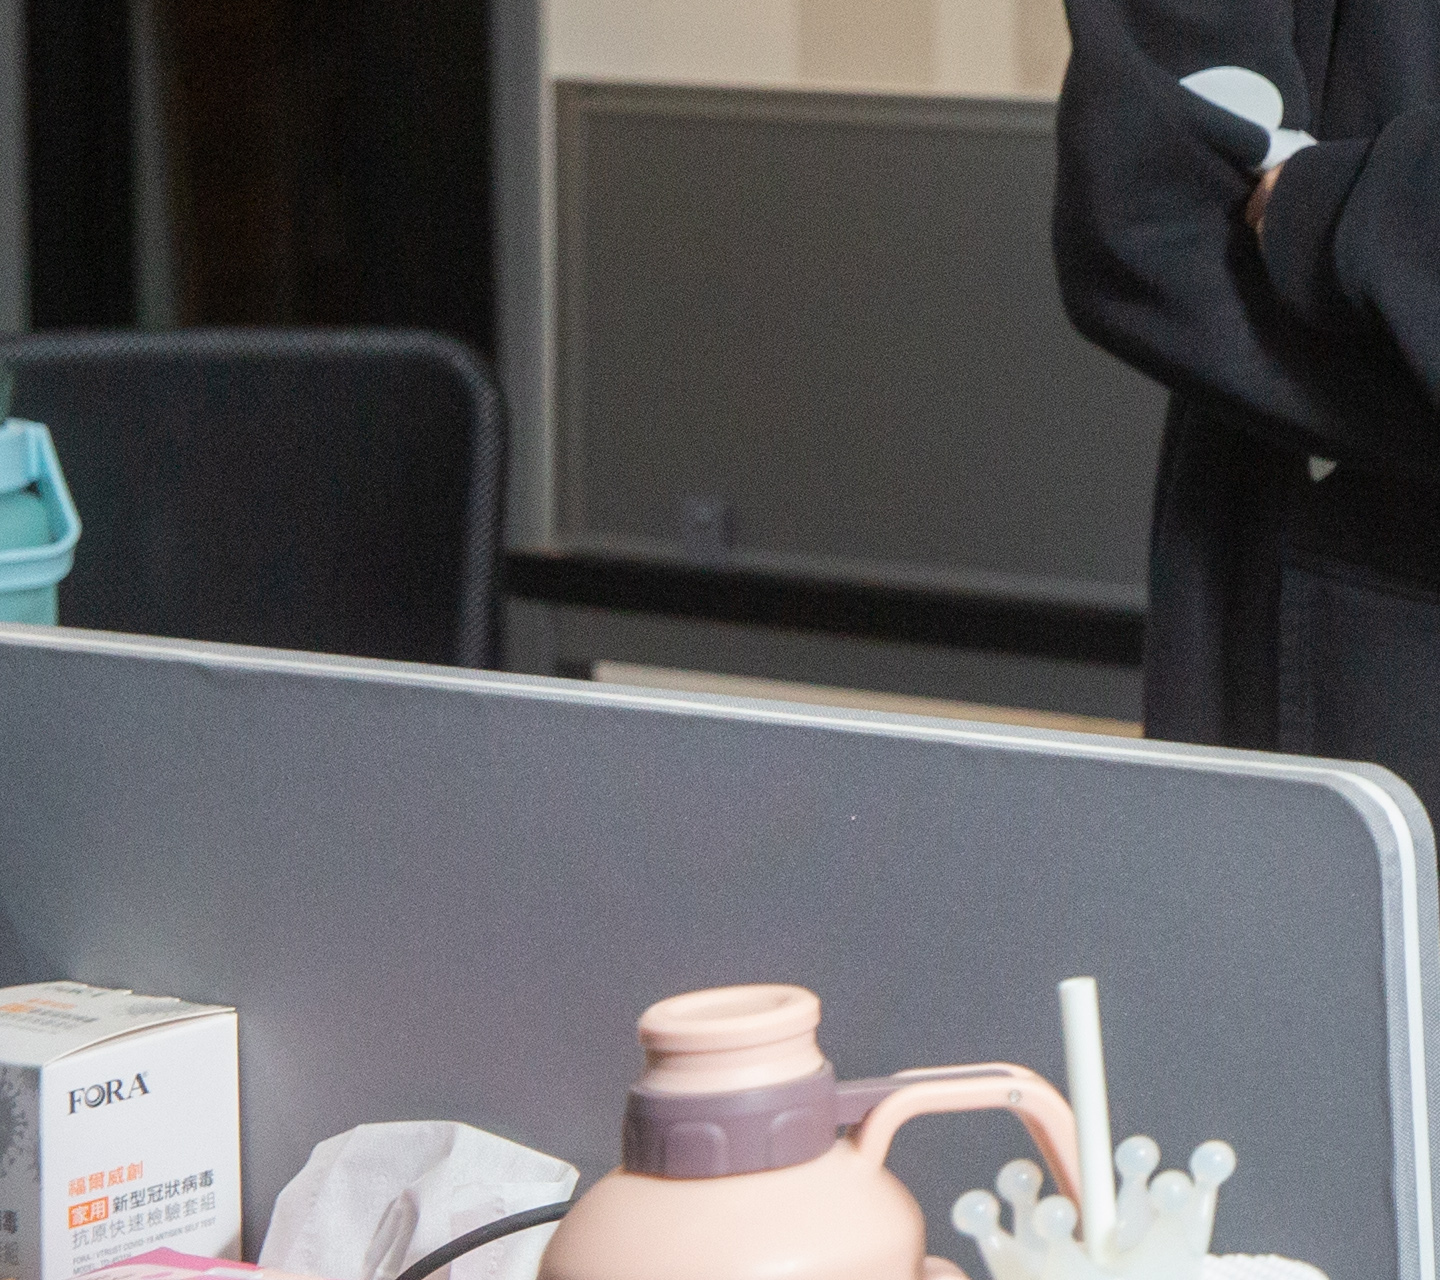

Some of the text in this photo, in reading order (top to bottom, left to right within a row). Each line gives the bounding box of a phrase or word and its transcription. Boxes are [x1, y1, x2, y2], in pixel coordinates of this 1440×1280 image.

[67, 1071, 151, 1116] FORA
[68, 1160, 144, 1197] 福爾威創
[112, 1169, 215, 1214] 新型冠狀病毒
[72, 1191, 216, 1250] 抗原快速檢驗套組
